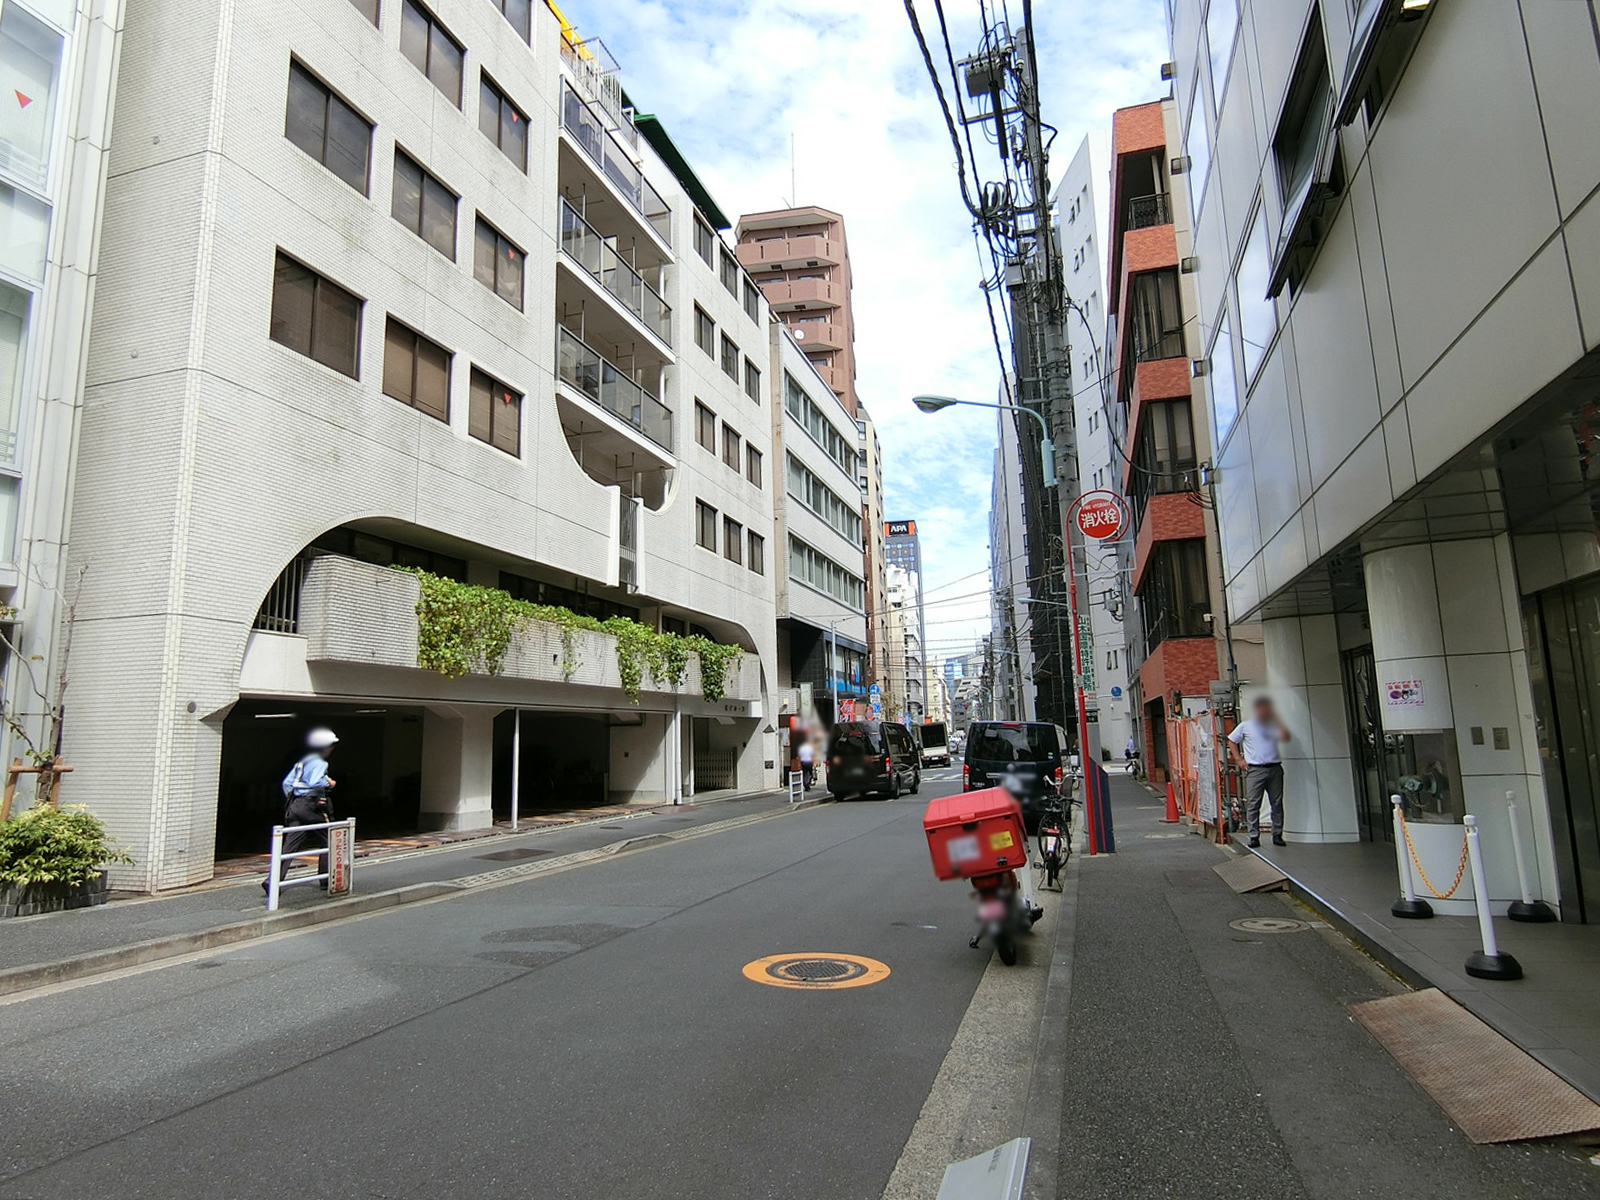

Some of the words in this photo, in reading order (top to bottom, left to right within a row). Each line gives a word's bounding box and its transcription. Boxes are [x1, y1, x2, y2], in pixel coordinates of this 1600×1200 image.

[1081, 508, 1118, 529] 消火栓
[890, 525, 907, 533] APA
